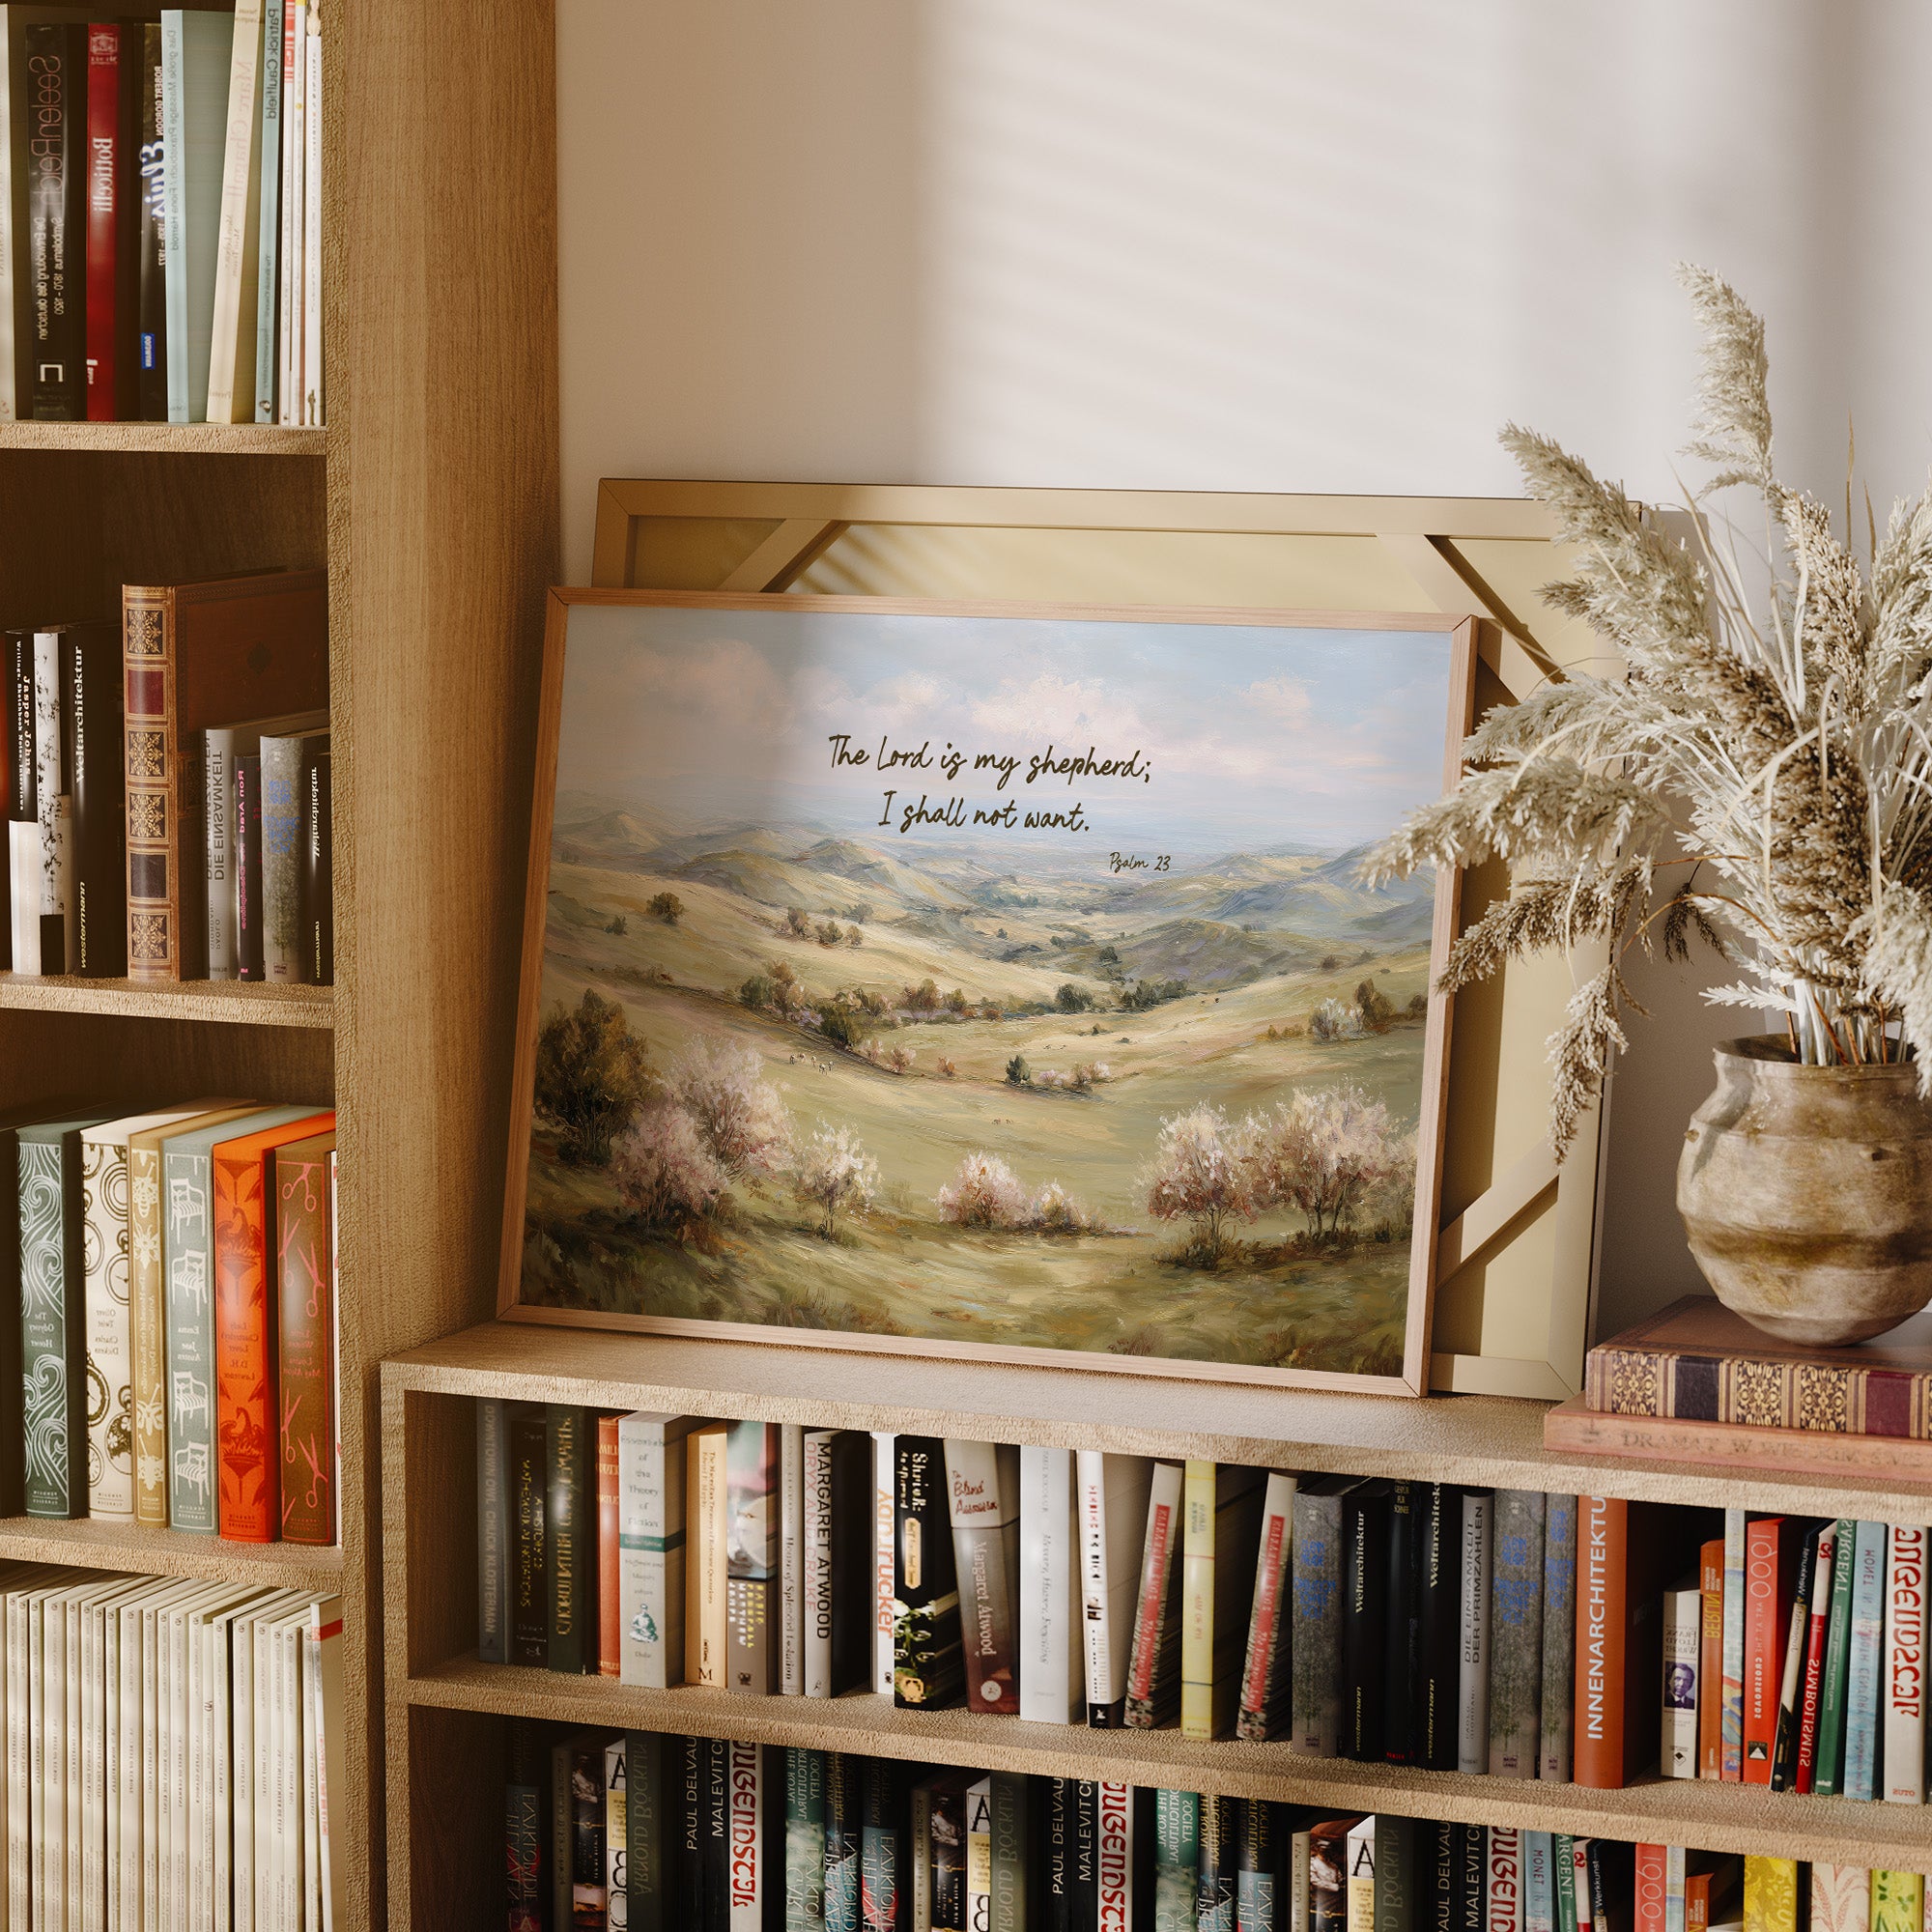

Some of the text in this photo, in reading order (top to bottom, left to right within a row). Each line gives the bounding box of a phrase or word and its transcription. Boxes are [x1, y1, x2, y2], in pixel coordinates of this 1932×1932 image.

[21, 676, 31, 725] Jasper
[74, 646, 86, 782] Weltarchitektur
[829, 733, 1151, 790] The Lord is my shepherd;
[878, 790, 1090, 833] I shall not want.
[1109, 851, 1172, 873] Psalm 23
[78, 882, 87, 968] westermann
[1622, 1425, 1719, 1449] DRAMAT
[1731, 1439, 1752, 1454] W
[484, 1406, 496, 1633] DOWNTOWN OWL CHUCK KLOSTERMAN
[628, 1485, 659, 1496] Theory
[953, 1479, 985, 1497] Blind
[628, 1518, 659, 1528] Fiction
[805, 1441, 816, 1612] ORYX AND CRAKE
[816, 1443, 830, 1639] MARGARET ATWOOD
[1430, 1483, 1440, 1588] Weltarchitek
[1355, 1511, 1365, 1613] Weltarchitektur
[1472, 1506, 1483, 1663] DER PRIMZAHLEN
[972, 1541, 997, 1656] Margaret Atwood
[1587, 1497, 1606, 1740] INNENARCHITEKTU
[697, 1667, 713, 1682] M
[686, 1737, 697, 1850] PAUL DELVAU
[1053, 1777, 1064, 1894] PAUL DELVAU
[1101, 1782, 1126, 1932] JUGENDST
[1438, 1822, 1450, 1889] DELVAU
[1533, 1849, 1543, 1886] MONET
[1558, 1834, 1573, 1898] ARGENT
[1591, 1861, 1604, 1907] Werkkunst
[1635, 1856, 1662, 1919] 1900
